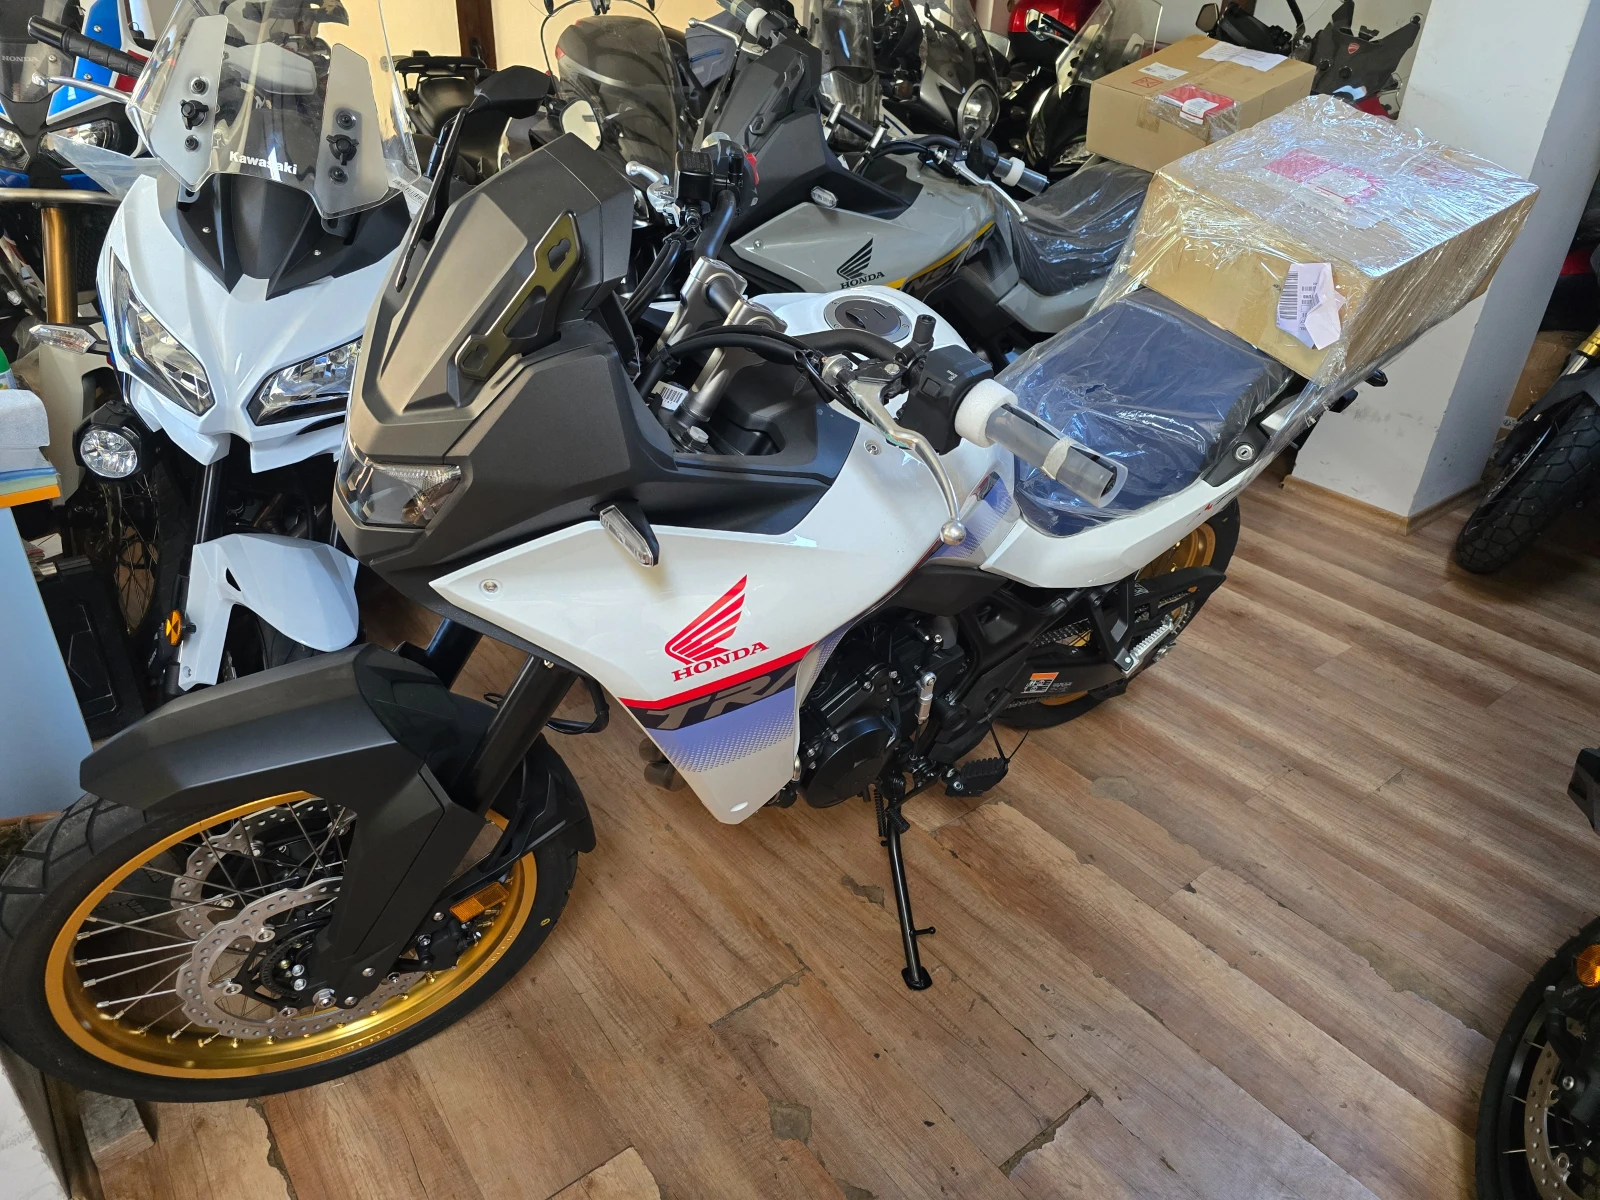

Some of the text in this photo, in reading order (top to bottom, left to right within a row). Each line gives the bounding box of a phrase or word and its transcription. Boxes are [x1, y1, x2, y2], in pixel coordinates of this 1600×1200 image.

[229, 151, 298, 175] Kawasaki
[840, 270, 885, 290] HONDA
[671, 641, 769, 682] HONDA
